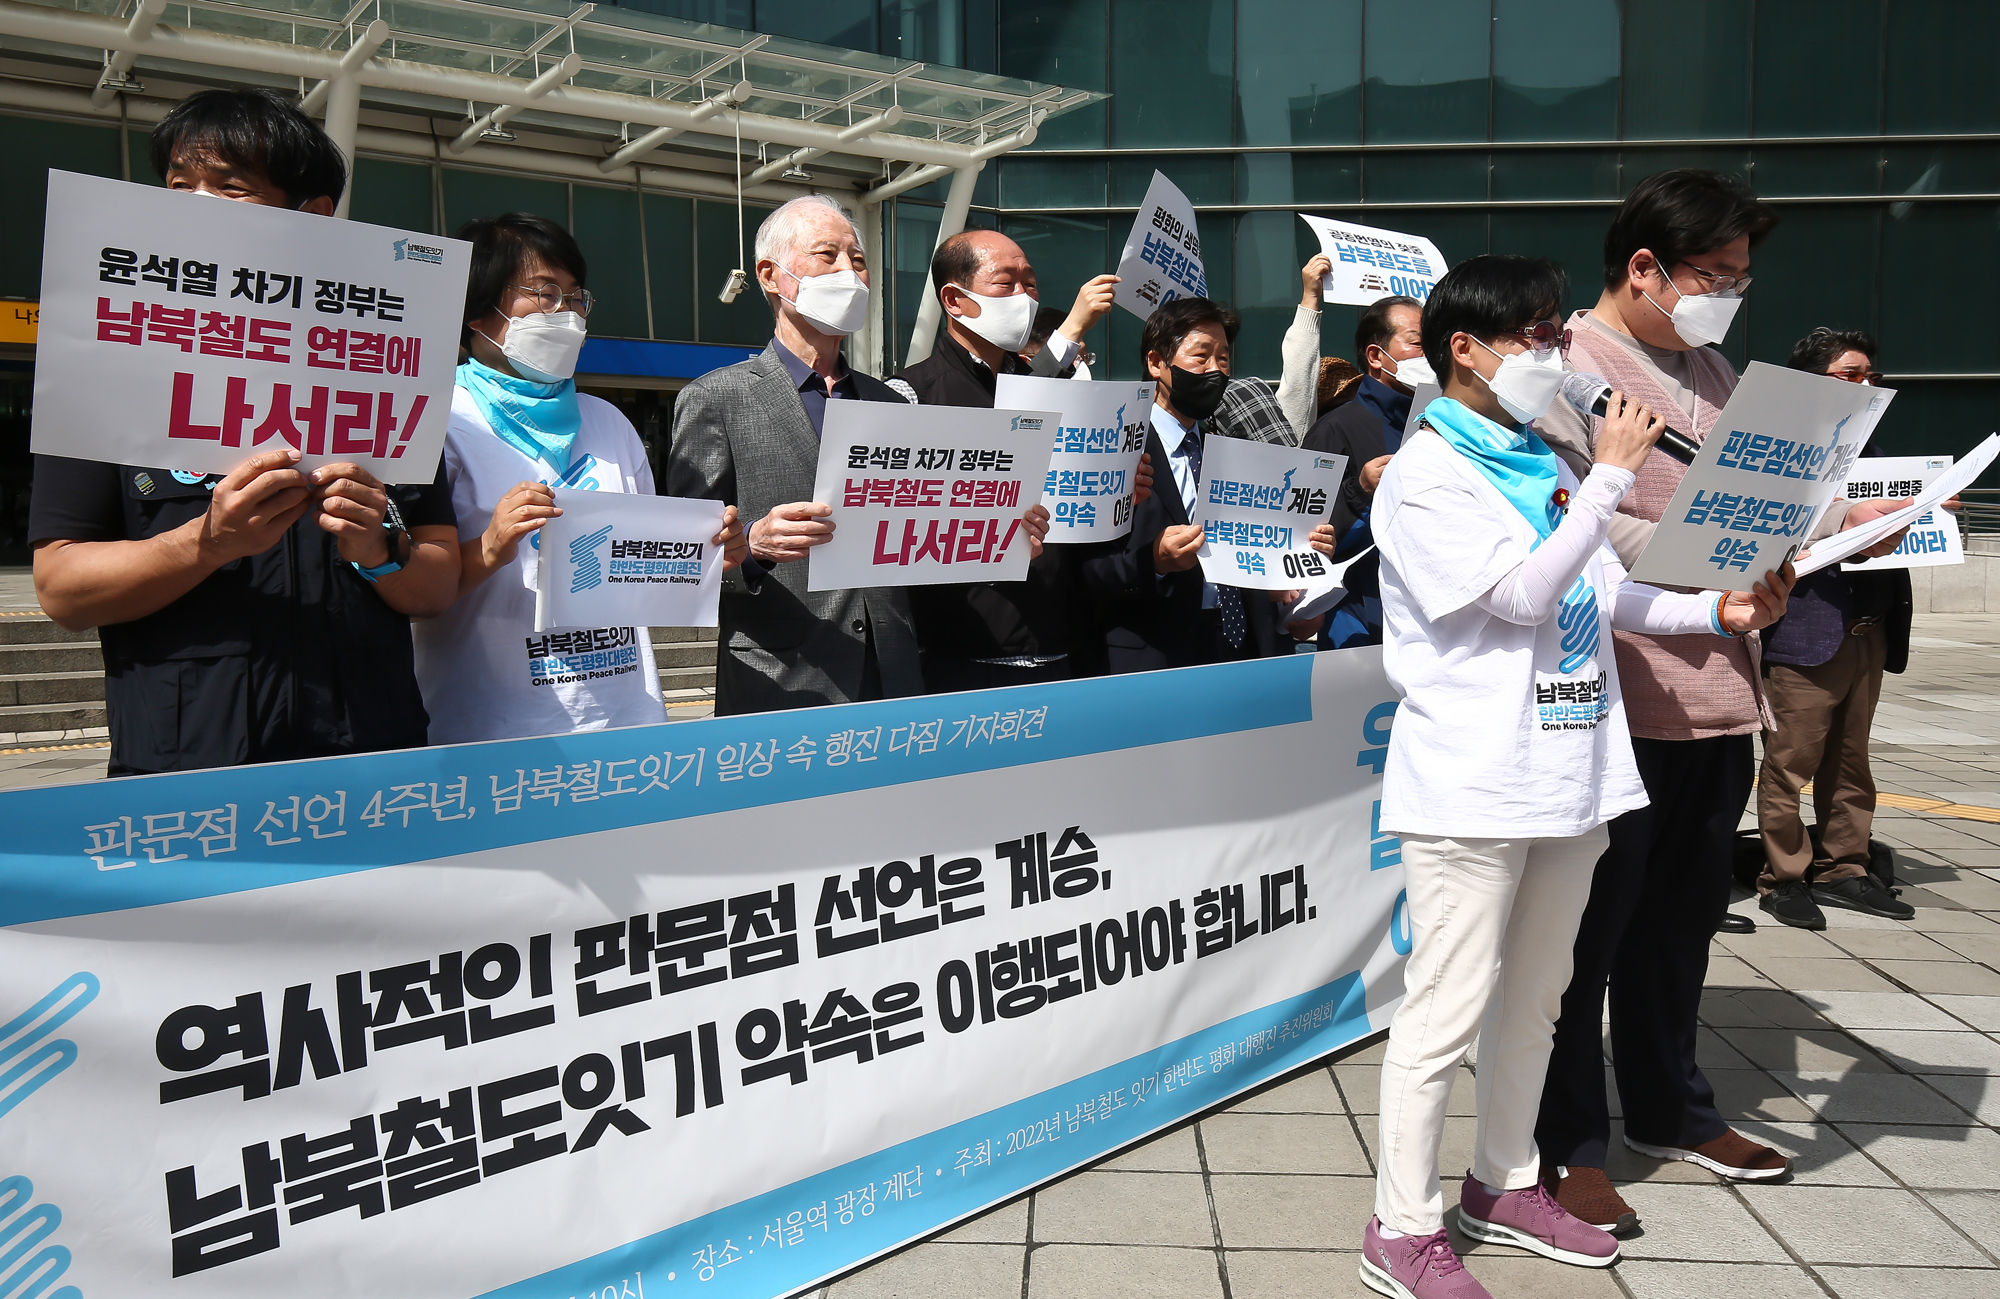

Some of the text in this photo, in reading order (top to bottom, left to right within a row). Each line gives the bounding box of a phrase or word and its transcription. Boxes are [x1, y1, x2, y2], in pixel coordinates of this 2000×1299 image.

[1152, 206, 1203, 262] 평화의 생명
[1327, 228, 1395, 250] 공동번영의
[1335, 242, 1432, 277] 남북철도를
[99, 247, 405, 322] 윤석열 차기 정부는
[96, 296, 421, 377] 남북철도 연결에
[168, 372, 429, 459] 나서라!
[1122, 421, 1145, 453] 계승
[848, 445, 1014, 472] 윤석열 차기 정부는
[1716, 430, 1859, 483] 판문점선언 계승
[842, 478, 1021, 508] 남북철도 연결에
[1209, 479, 1327, 515] 판문점선언 계승
[1847, 480, 1923, 499] 평화의 생명줄
[1055, 502, 1096, 528] 약속
[1683, 489, 1818, 538] 남북철도잇기
[611, 540, 704, 560] 남북철도잇기
[872, 518, 1022, 566] 나서라!
[1203, 520, 1293, 550] 남북철도잇기
[609, 560, 702, 575] 한반도평화대행진
[1236, 551, 1326, 578] 약속 이행
[1708, 537, 1759, 573] 약속
[608, 575, 622, 583] One
[669, 576, 701, 585] Railway
[525, 627, 635, 659] 남북철도잇기
[529, 646, 637, 677] 한반도평화대행진
[532, 677, 555, 686] One
[557, 673, 587, 684] Korea
[589, 668, 613, 679] Peace
[1542, 722, 1561, 730] One
[1563, 722, 1588, 730] Korea
[83, 705, 1049, 872] 판문점 선언 4주년, 남북철도잇기 일상 속 행진 다짐 기자회견
[156, 825, 1113, 1104] 역사적인 판문점 선언은 계승,
[165, 1021, 724, 1279] 남북철도잇기
[735, 981, 924, 1086] 약속은
[936, 898, 1187, 1034] 이행되어야
[1194, 864, 1317, 960] 합니다.
[691, 1238, 742, 1282] 장소
[760, 1201, 828, 1250] 서울역
[834, 1183, 876, 1226] 광장
[882, 1165, 924, 1202] 계단
[953, 1138, 992, 1177] 주최
[1005, 1117, 1062, 1155] 2022년
[1066, 1092, 1128, 1133] 남북철도
[1131, 1071, 1160, 1108] 잇기
[1163, 1055, 1206, 1093] 한반도
[1208, 1045, 1236, 1074] 평화
[1238, 1025, 1277, 1059] 대행진
[1279, 1000, 1334, 1042] 추진위원회
